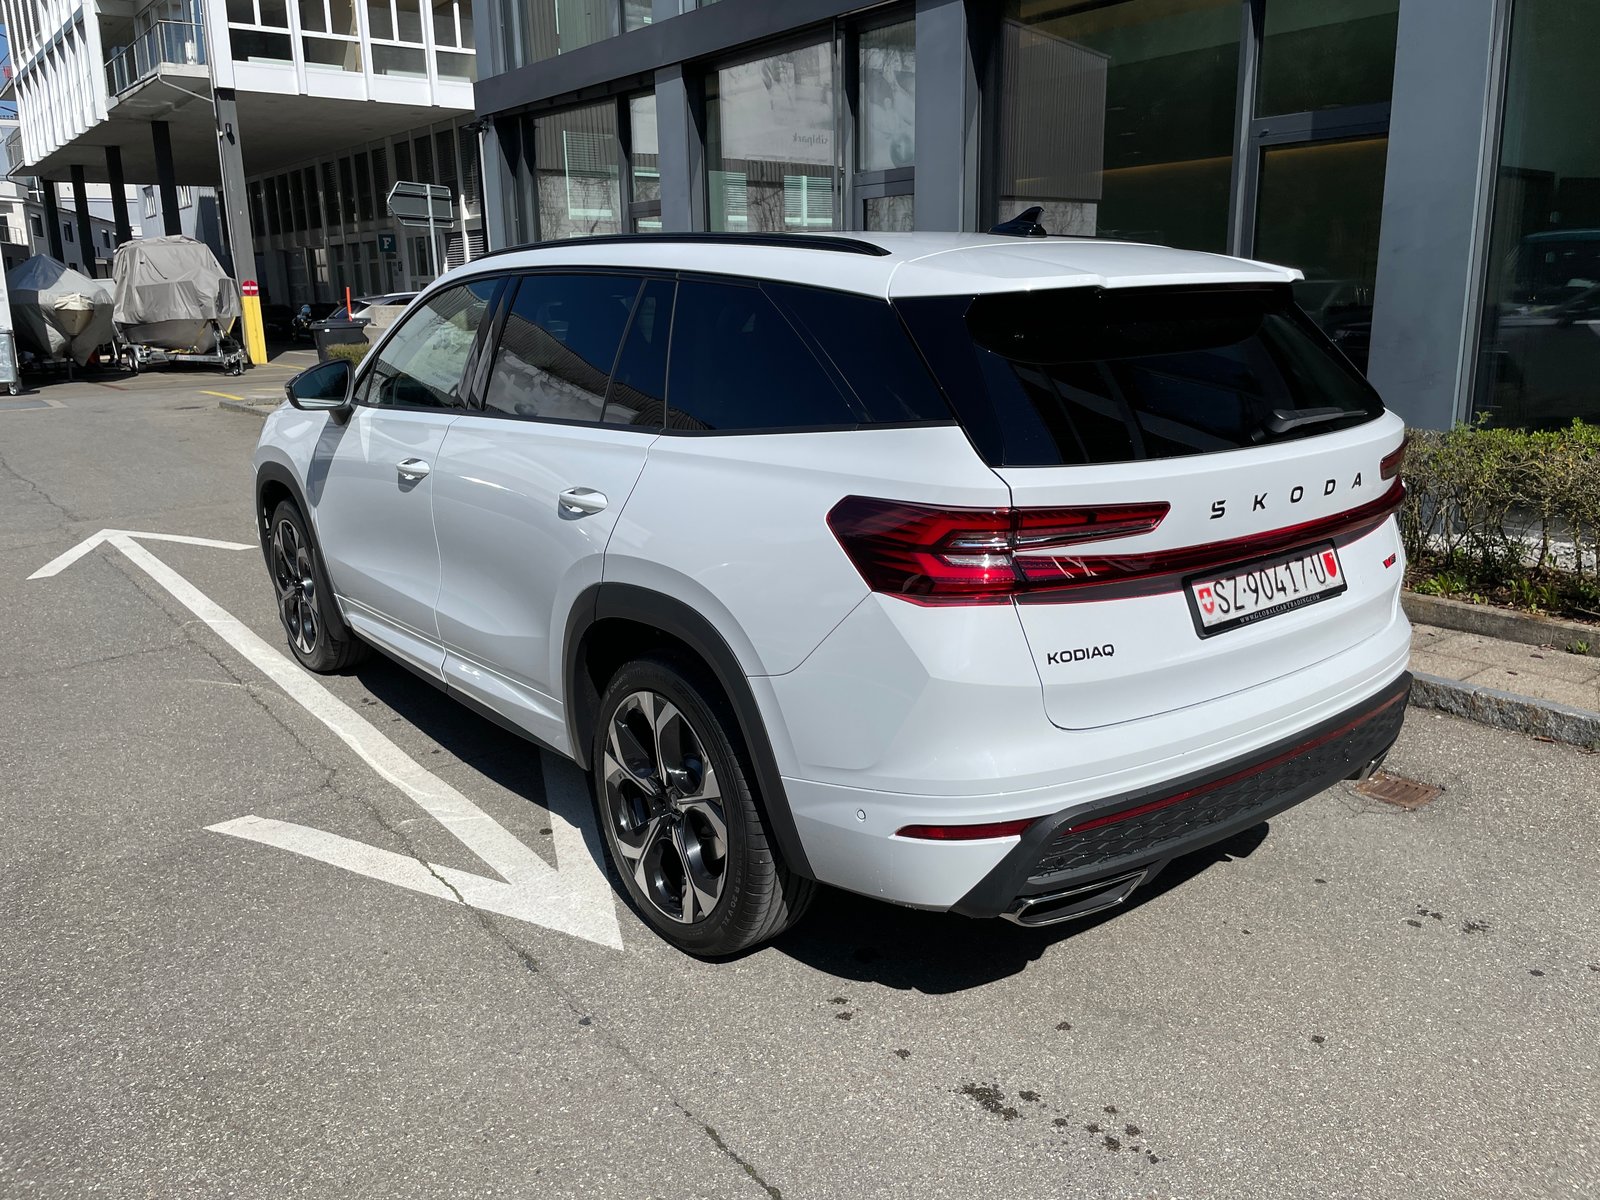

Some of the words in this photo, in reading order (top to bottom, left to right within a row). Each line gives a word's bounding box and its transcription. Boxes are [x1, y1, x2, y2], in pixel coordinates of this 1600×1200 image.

[382, 237, 391, 249] F
[1209, 472, 1362, 520] SKODA
[1047, 644, 1115, 665] KODIAQ
[730, 894, 738, 908] 20
